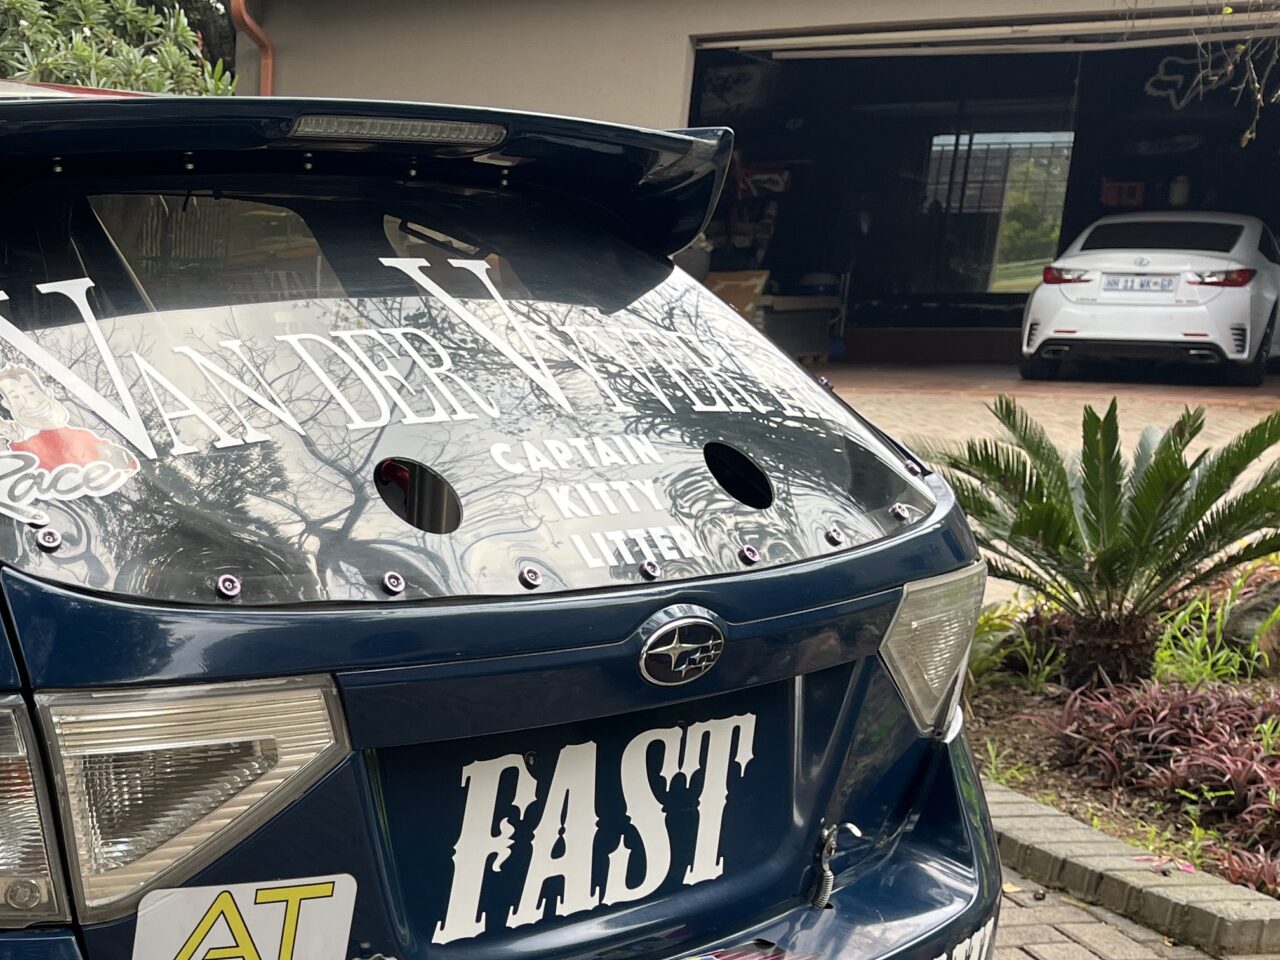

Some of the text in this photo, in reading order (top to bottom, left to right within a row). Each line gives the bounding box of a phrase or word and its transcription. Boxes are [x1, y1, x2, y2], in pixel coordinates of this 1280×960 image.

[274, 327, 502, 430] DER
[490, 436, 664, 475] CAPTAIN
[548, 479, 665, 520] KITTY
[572, 524, 703, 568] LITTER
[431, 712, 757, 945] FAST
